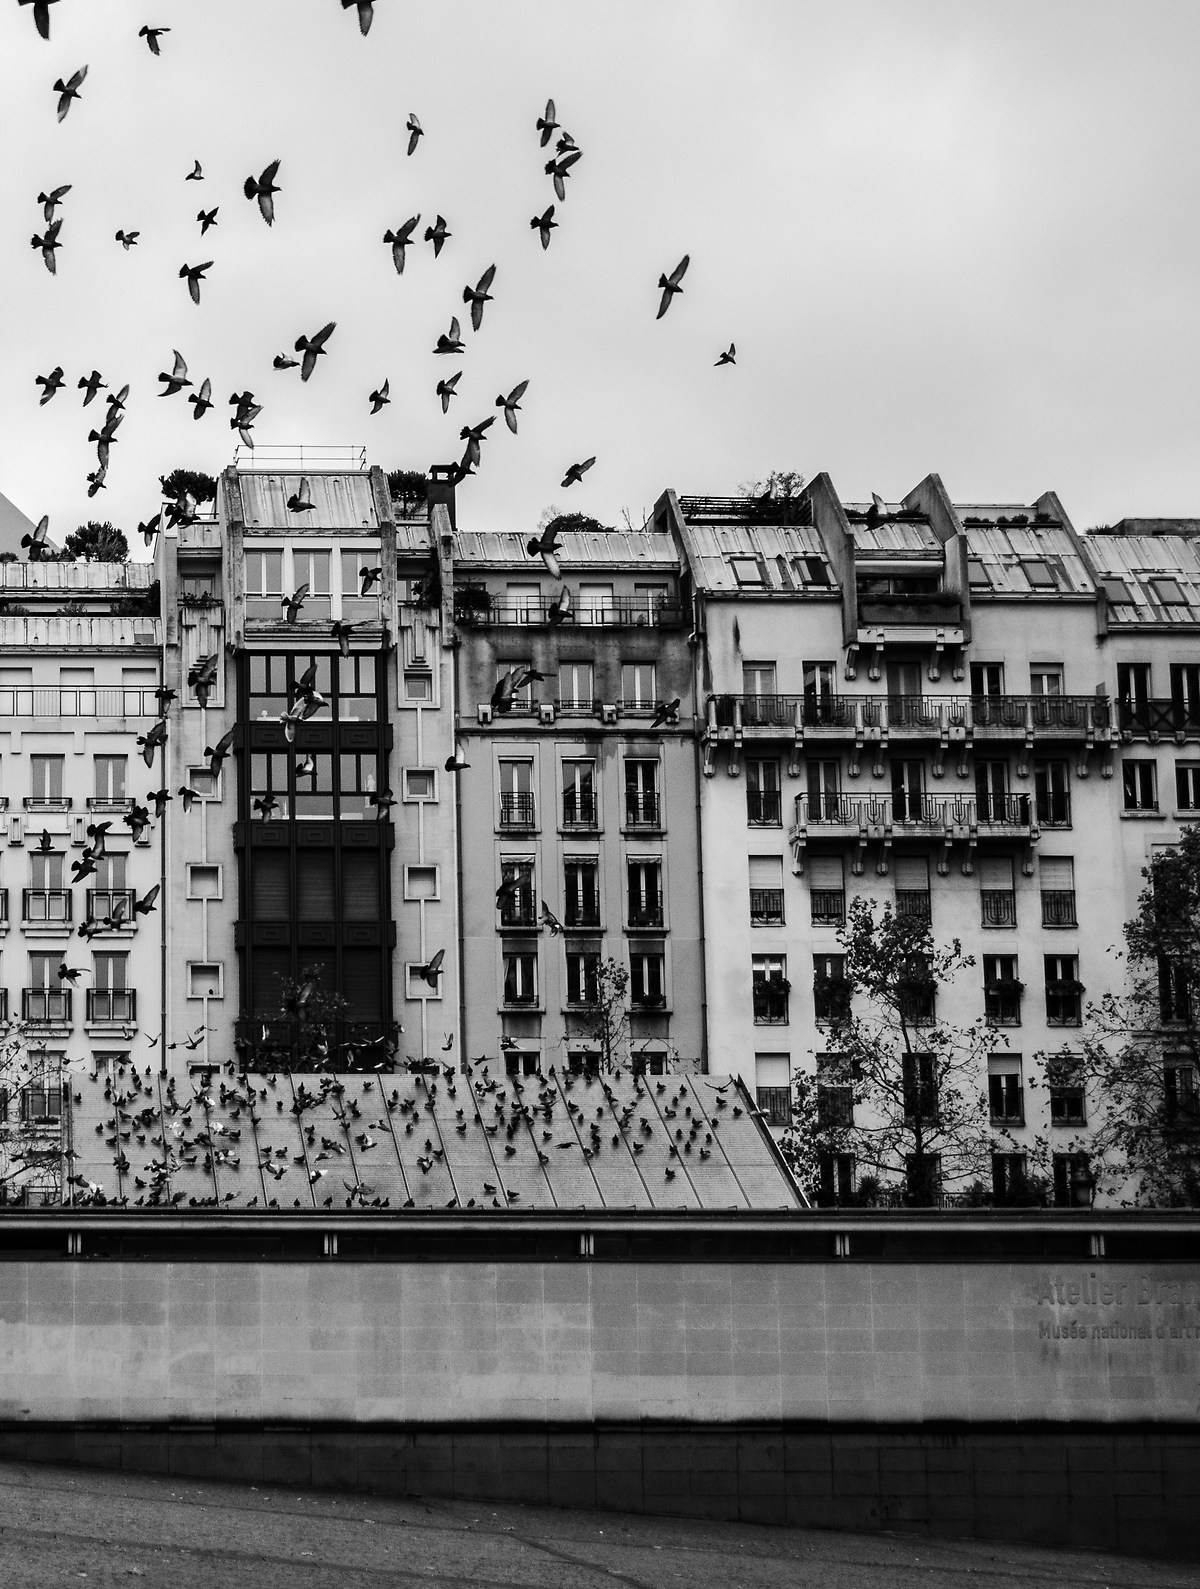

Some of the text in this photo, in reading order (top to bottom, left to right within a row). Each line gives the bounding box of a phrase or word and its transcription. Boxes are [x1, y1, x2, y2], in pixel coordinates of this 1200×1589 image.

[1037, 1272, 1127, 1305] Atelier
[1039, 1319, 1087, 1339] Musée
[1092, 1319, 1152, 1339] national
